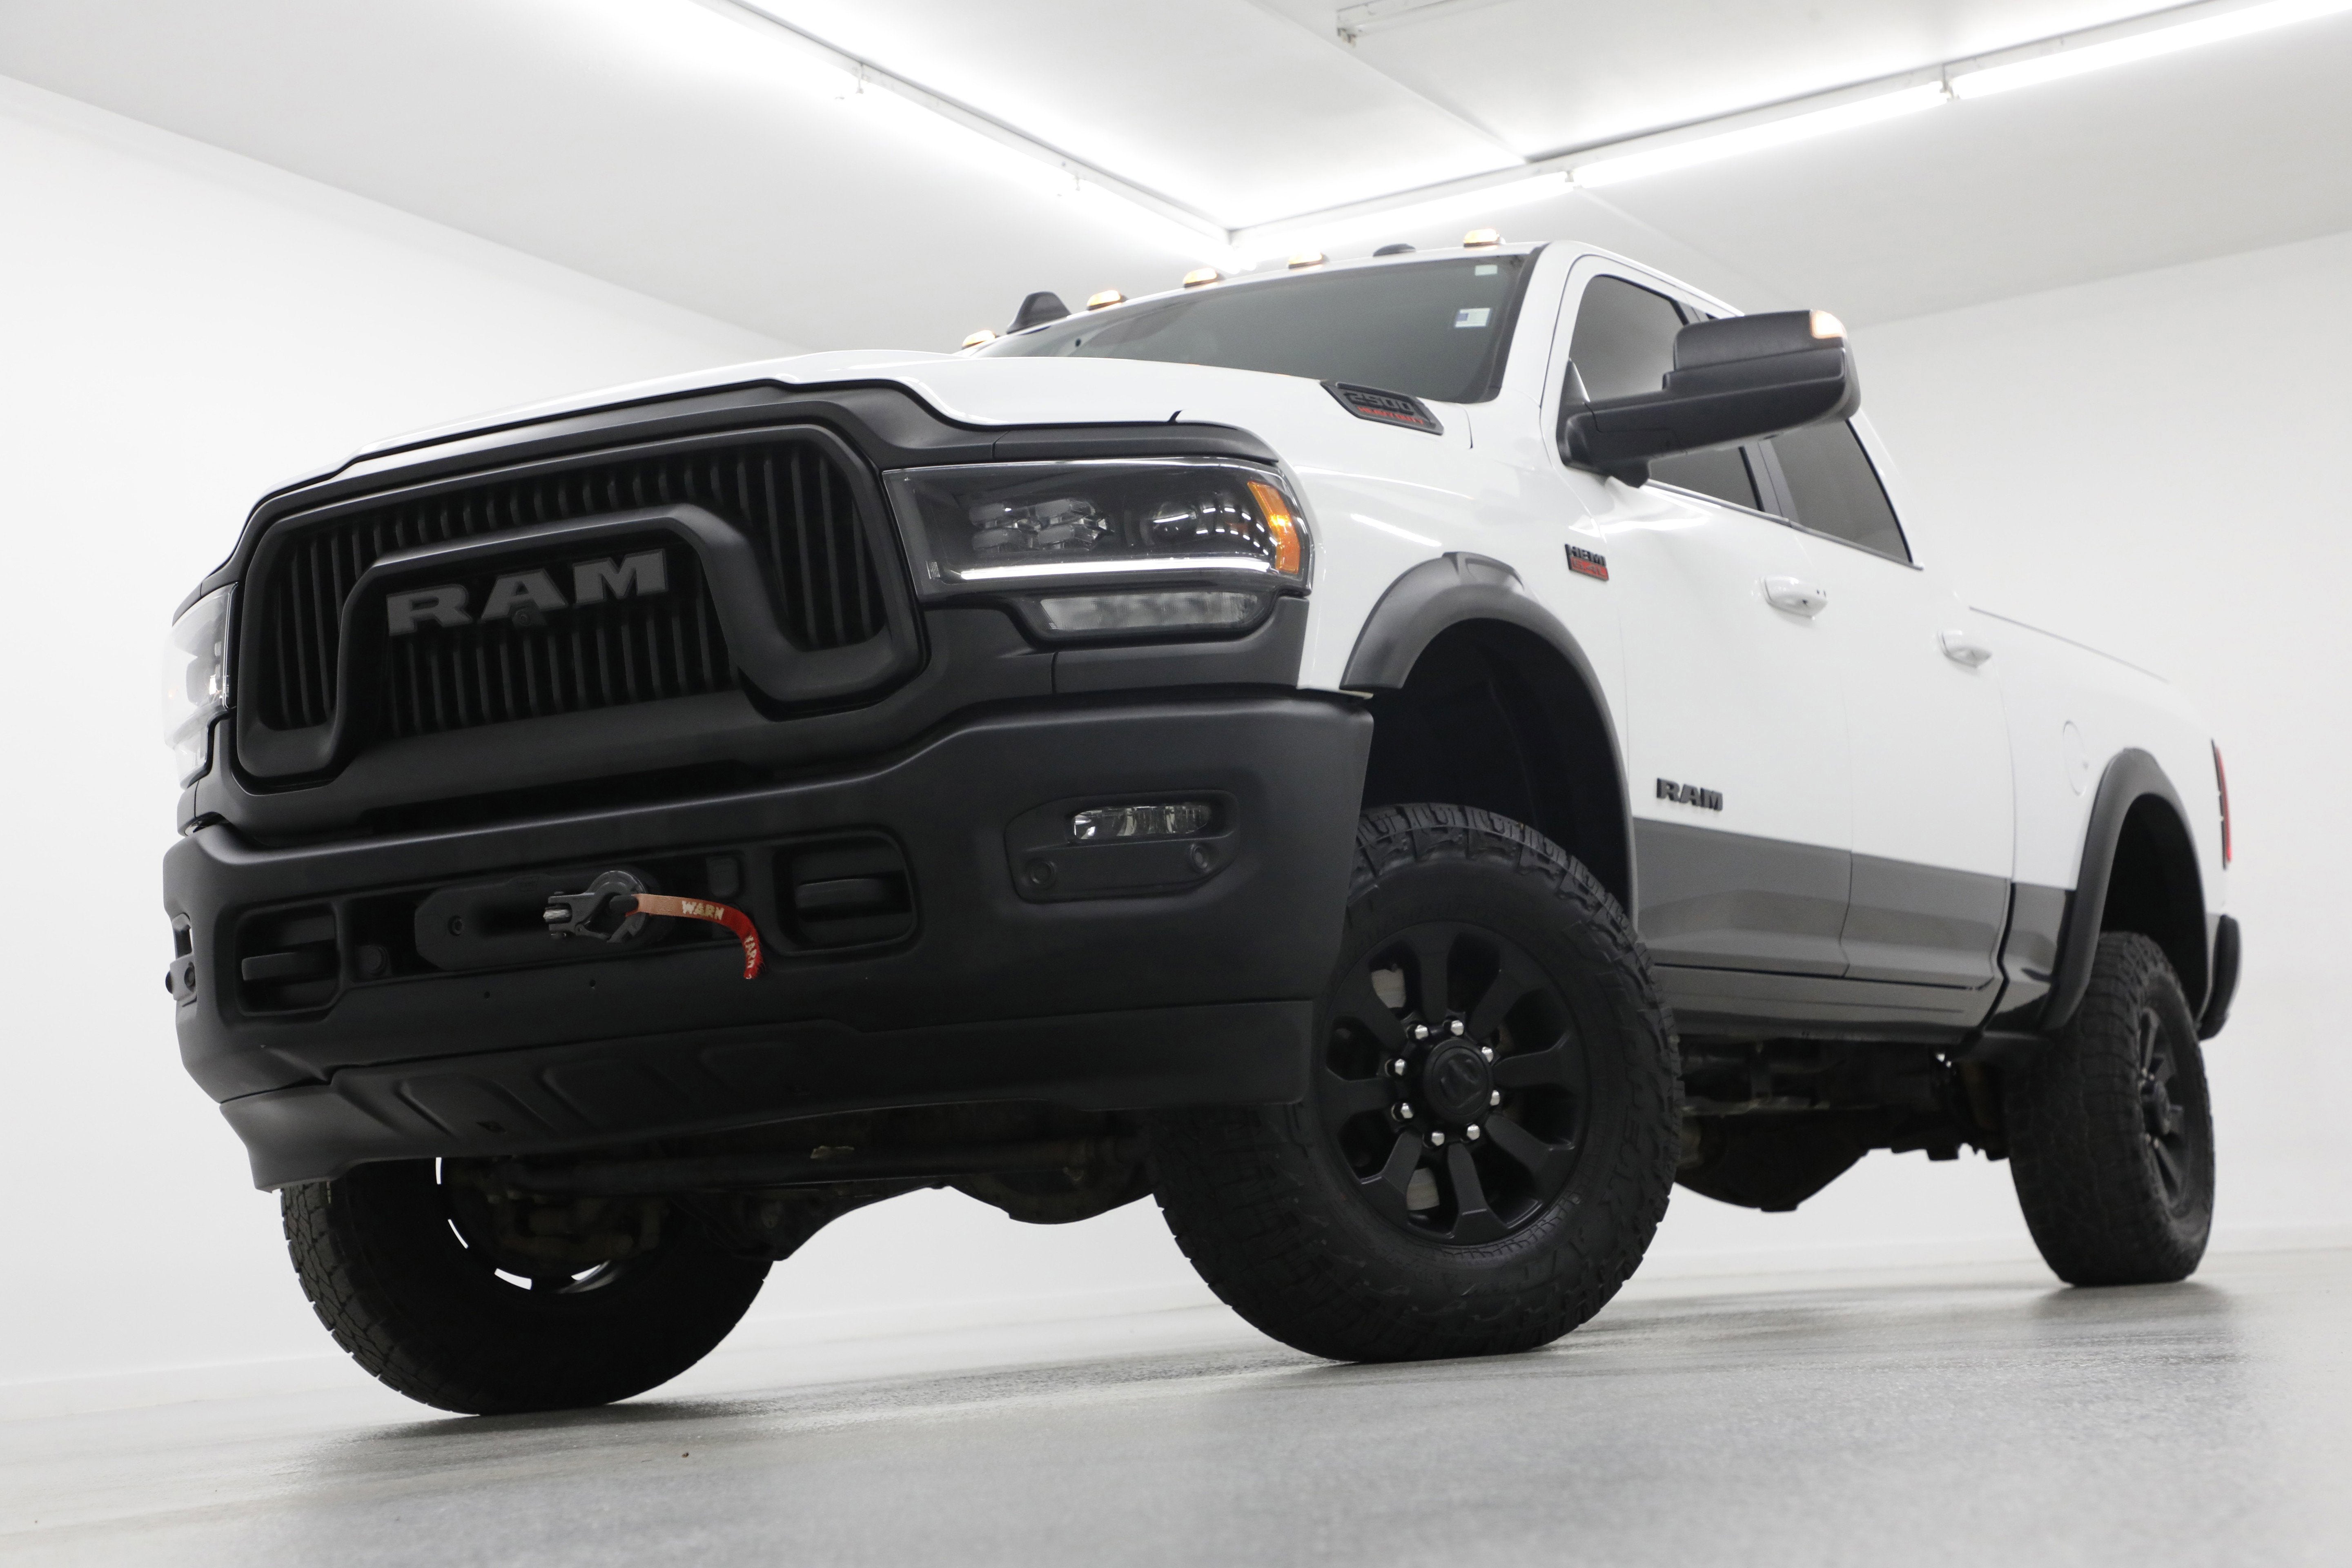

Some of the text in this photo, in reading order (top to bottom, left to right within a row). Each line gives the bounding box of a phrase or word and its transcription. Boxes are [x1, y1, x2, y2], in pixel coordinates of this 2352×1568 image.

[1343, 390, 1414, 416] 2500
[1564, 543, 1607, 570] HEMI
[386, 549, 668, 635] RAM
[1656, 777, 1723, 811] RAM
[682, 900, 724, 920] WARN
